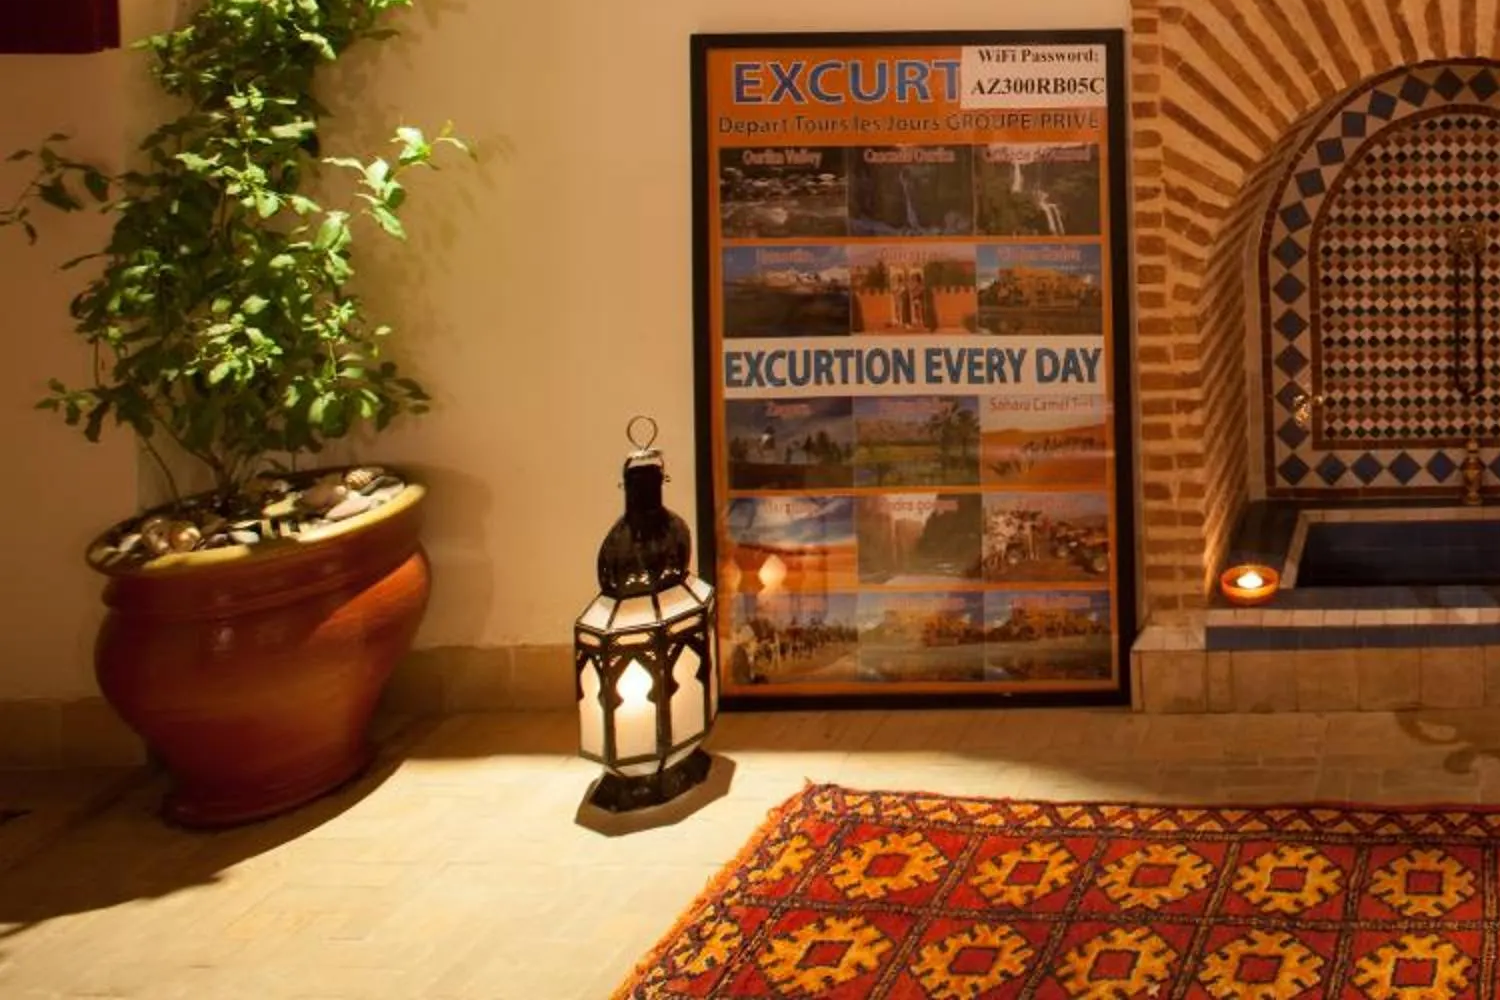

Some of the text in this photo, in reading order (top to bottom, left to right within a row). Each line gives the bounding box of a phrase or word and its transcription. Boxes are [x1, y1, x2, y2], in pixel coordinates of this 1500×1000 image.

[978, 48, 1099, 62] WiFi Password:
[971, 77, 1104, 95] AZ300RB05C
[725, 346, 1102, 387] EXCURTION EVERY DAY
